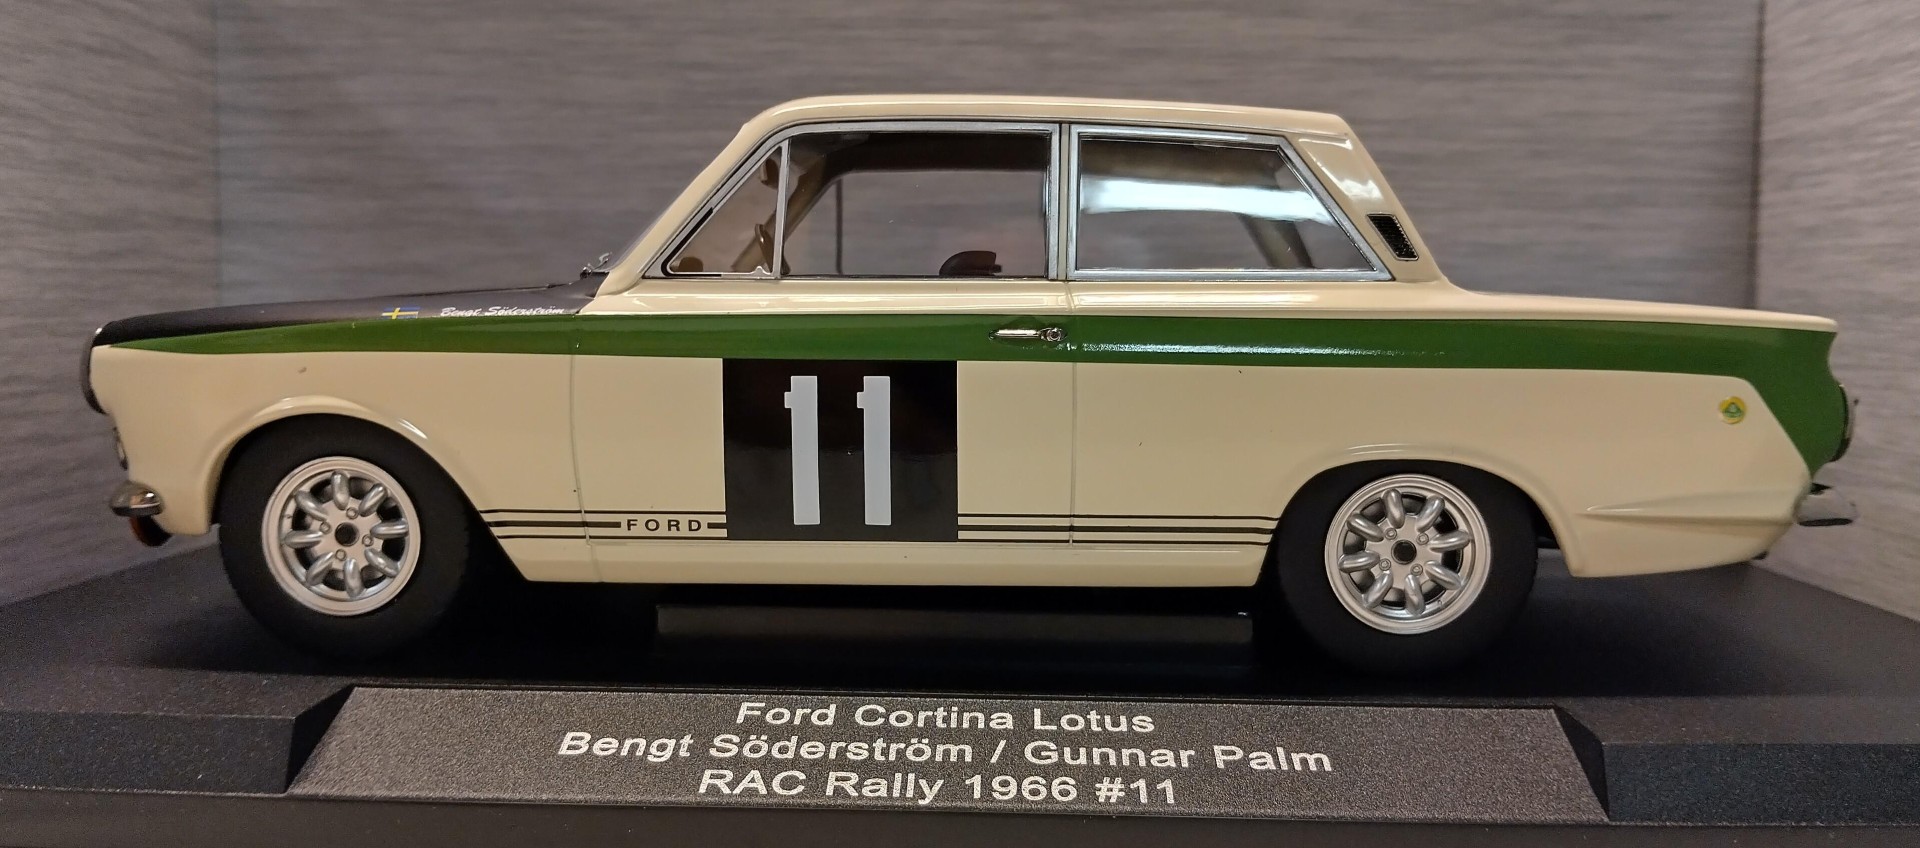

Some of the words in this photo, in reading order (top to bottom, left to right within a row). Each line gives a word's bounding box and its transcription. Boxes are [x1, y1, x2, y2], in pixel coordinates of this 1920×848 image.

[440, 306, 482, 317] Bengt
[484, 305, 564, 316] Söderström
[784, 375, 892, 526] 11
[626, 518, 702, 532] FORD
[736, 701, 836, 727] Ford
[854, 703, 1014, 730] Cortina
[1033, 707, 1155, 733] Lotus
[557, 731, 694, 764] Bengt
[708, 733, 973, 763] Söderström
[989, 739, 1007, 764] /
[1024, 740, 1196, 769] Gunnar
[1213, 744, 1333, 772] Palm
[697, 768, 807, 797] RAC
[825, 770, 945, 806] Rally
[964, 774, 1078, 803] 1966
[1094, 776, 1175, 805] #11
